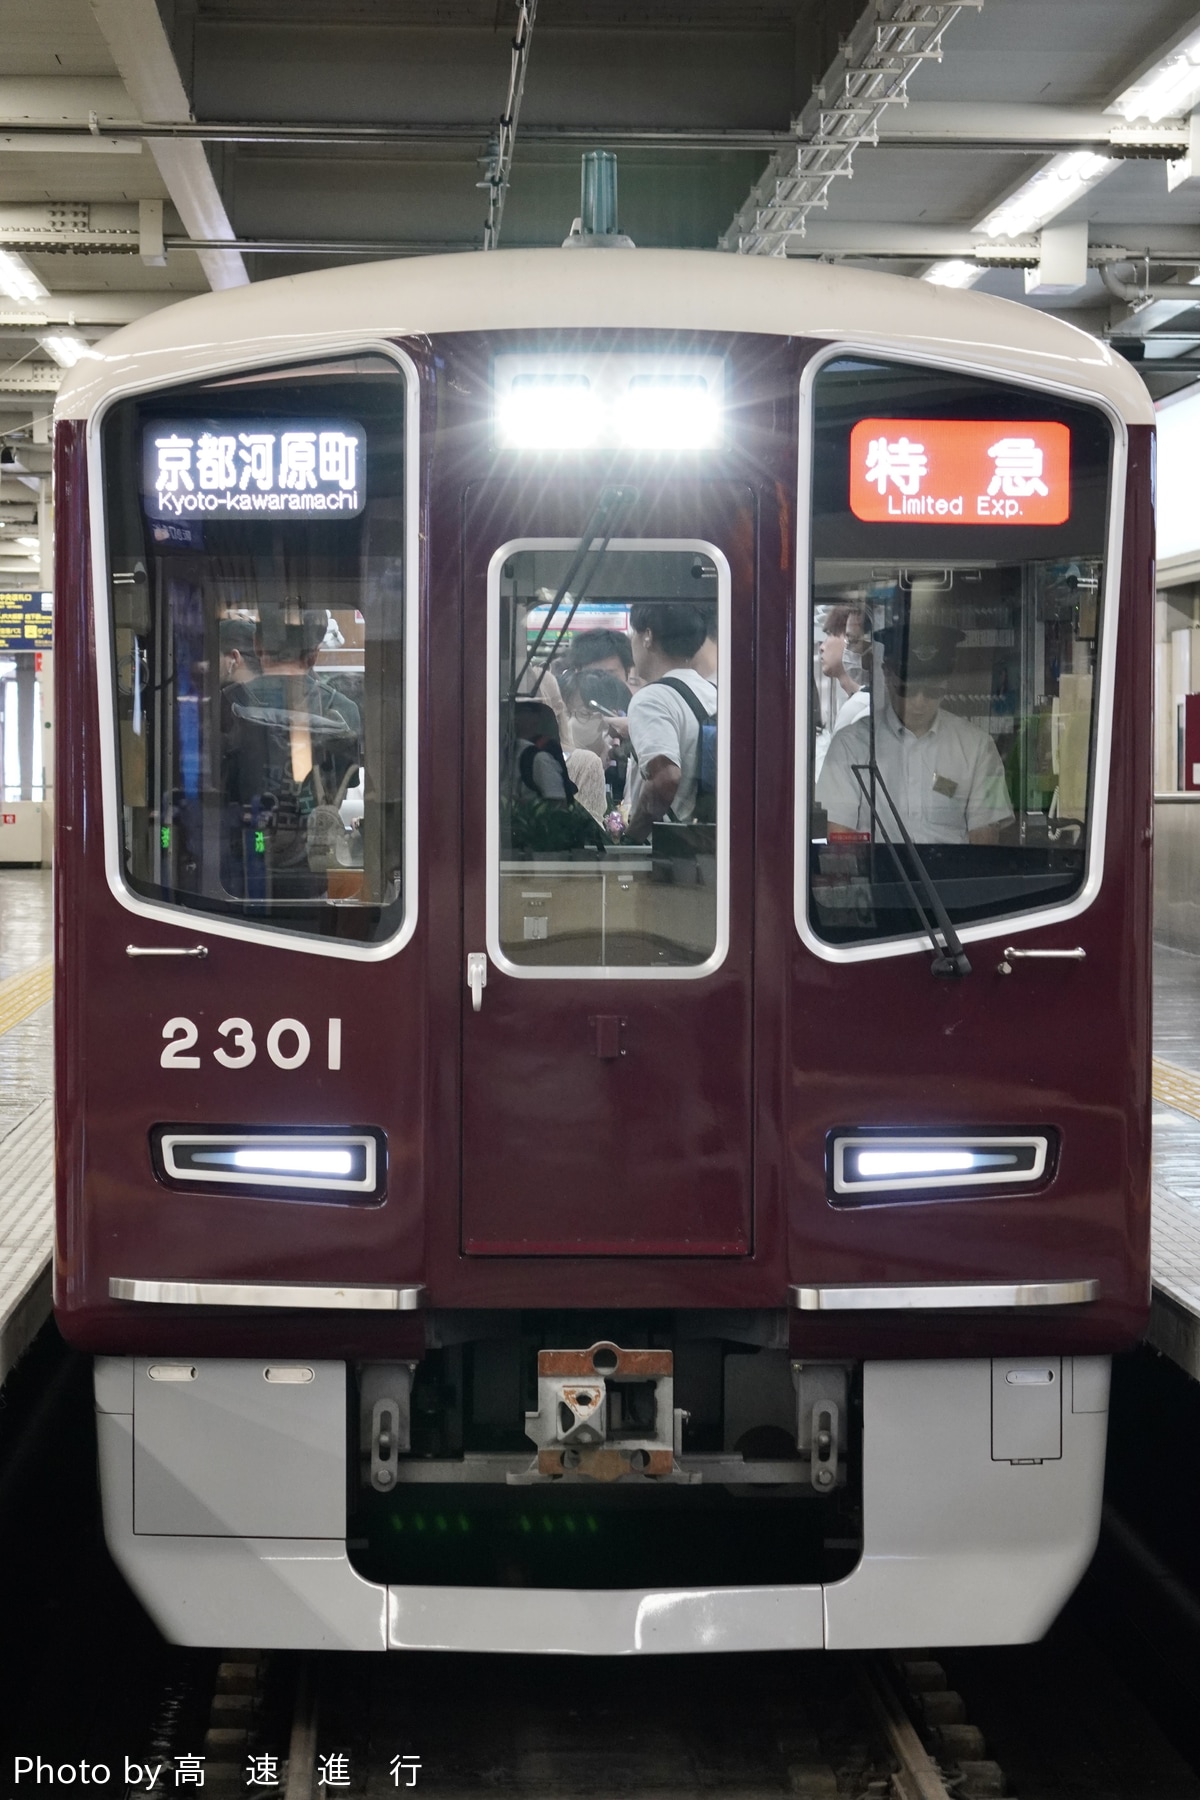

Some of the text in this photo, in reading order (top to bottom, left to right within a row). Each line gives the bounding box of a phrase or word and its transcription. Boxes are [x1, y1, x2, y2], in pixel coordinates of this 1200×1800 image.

[155, 432, 358, 490] 京都河原町
[865, 437, 1049, 497] 特急
[158, 490, 358, 516] Kyoto-kawaramachi
[888, 495, 1024, 518] Limited Exp.
[160, 1016, 342, 1071] 2301
